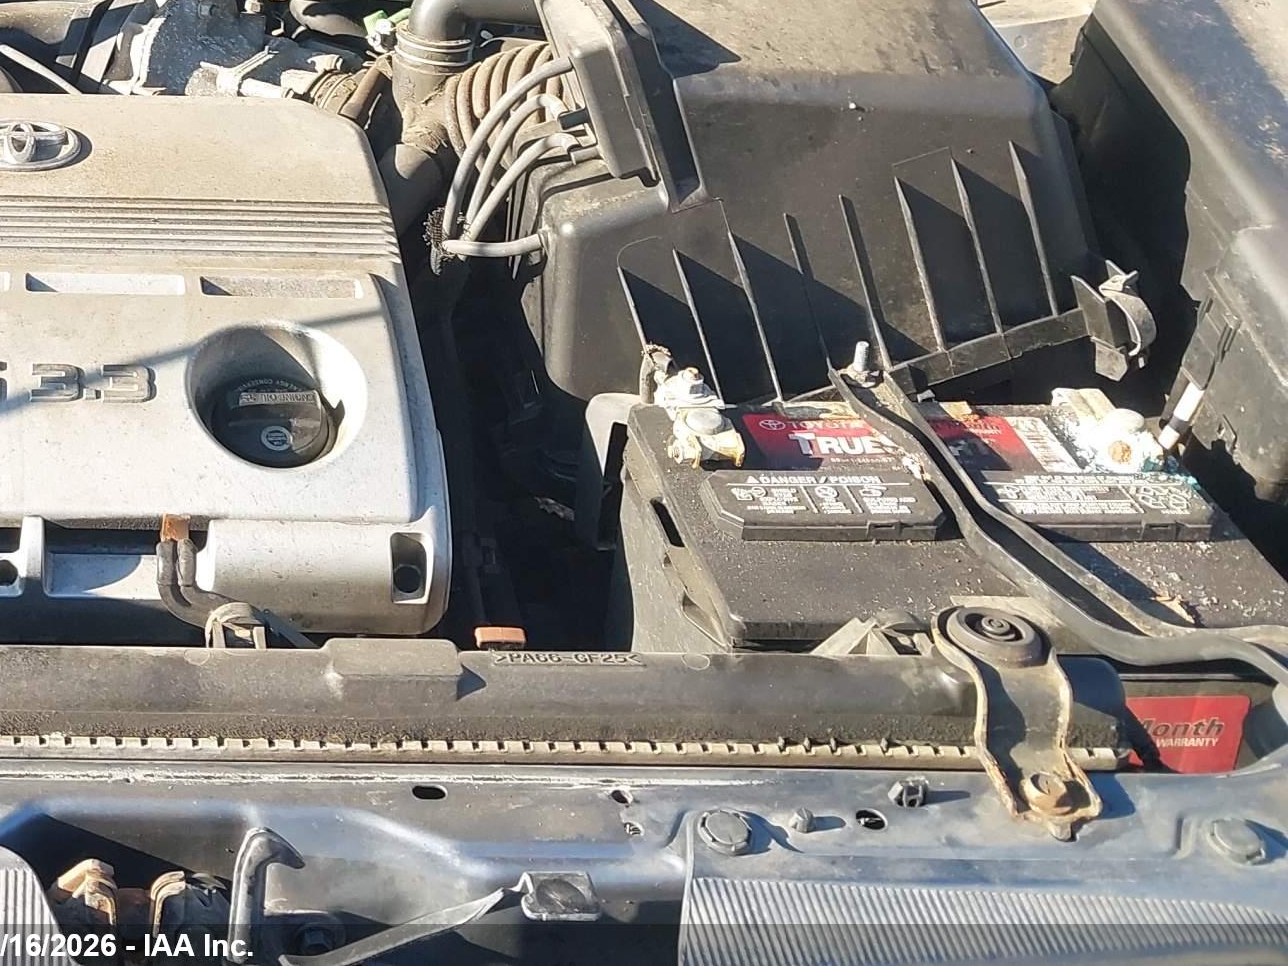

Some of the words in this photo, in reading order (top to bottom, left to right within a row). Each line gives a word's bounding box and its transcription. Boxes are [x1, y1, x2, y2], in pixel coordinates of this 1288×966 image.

[29, 362, 159, 403] 3.3
[760, 475, 818, 484] DANGER
[829, 475, 882, 484] POISON
[1156, 737, 1219, 748] WARRANTY
